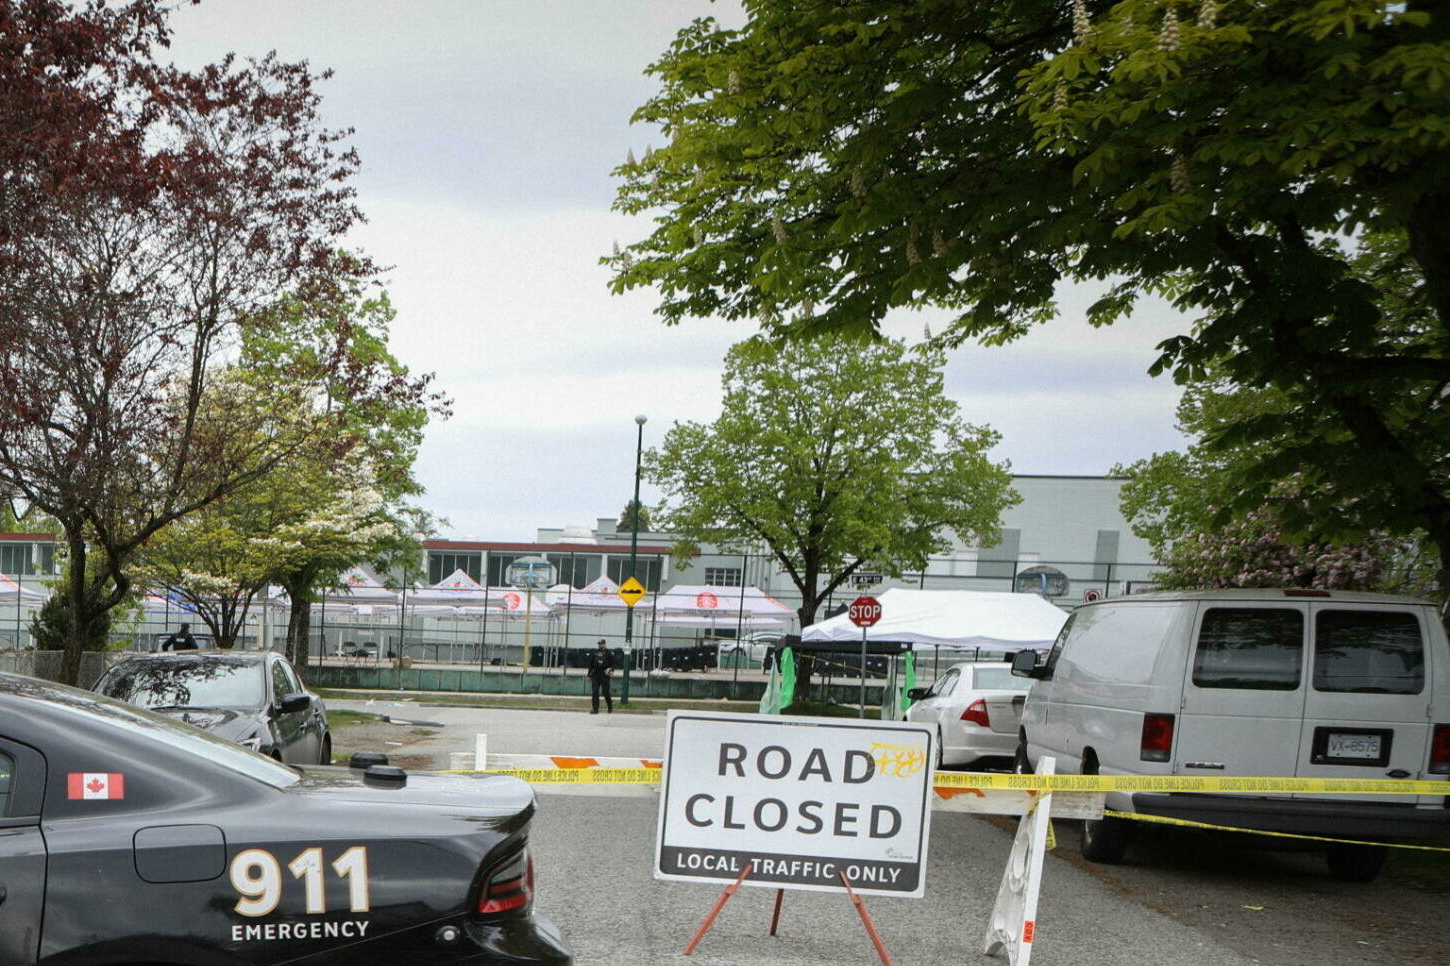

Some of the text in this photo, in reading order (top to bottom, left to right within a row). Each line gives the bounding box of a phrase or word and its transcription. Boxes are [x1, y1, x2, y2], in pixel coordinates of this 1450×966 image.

[850, 605, 880, 618] STOP
[718, 742, 876, 784] ROAD
[685, 793, 902, 839] CLOSED
[229, 846, 369, 917] 911
[677, 853, 901, 883] LOCAL TRAFFIC ONLY
[231, 920, 370, 941] EMERGENCY
